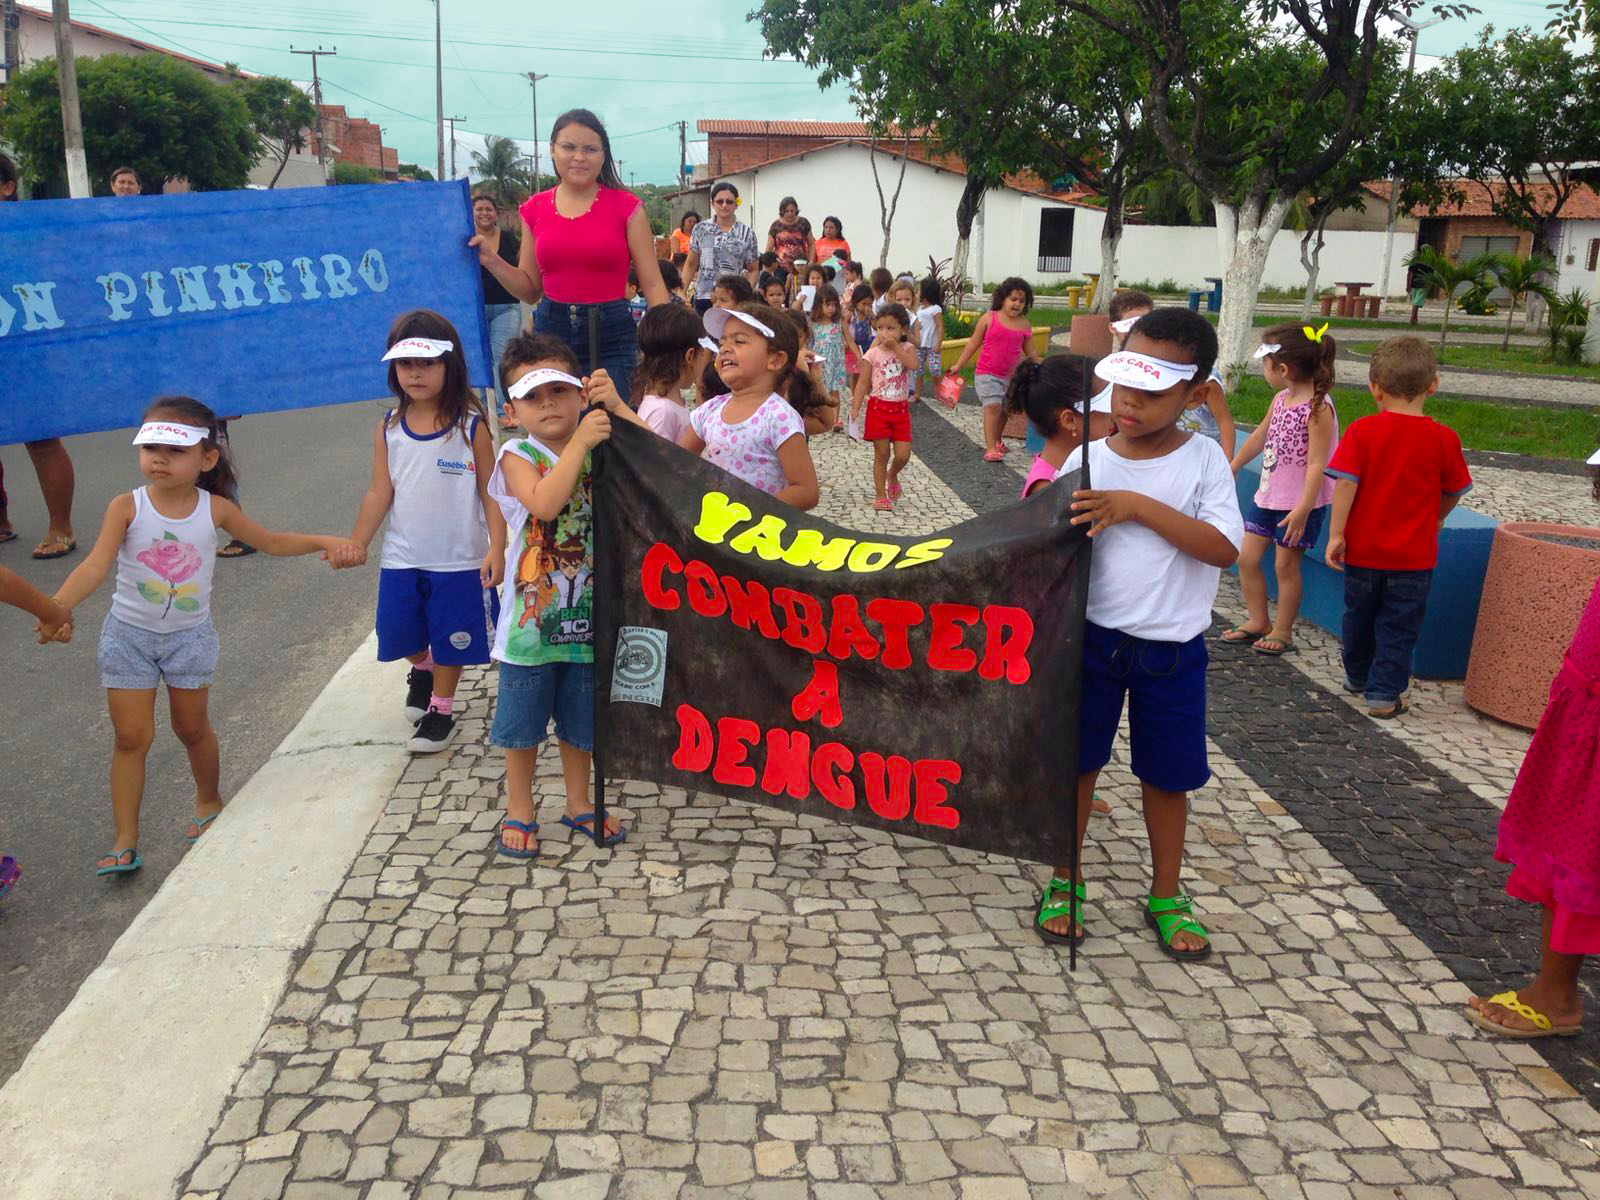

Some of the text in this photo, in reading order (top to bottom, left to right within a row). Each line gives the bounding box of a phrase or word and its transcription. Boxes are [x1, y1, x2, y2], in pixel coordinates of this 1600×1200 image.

[96, 248, 390, 321] PINHEIRO
[1127, 358, 1161, 380] CAÇA
[157, 425, 189, 438] CAÇA
[560, 608, 589, 620] BEN
[641, 542, 1035, 685] COMBATER
[560, 619, 590, 634] 10
[611, 694, 661, 704] ENGUE
[791, 659, 844, 728] A
[672, 703, 961, 830] DENGUE
